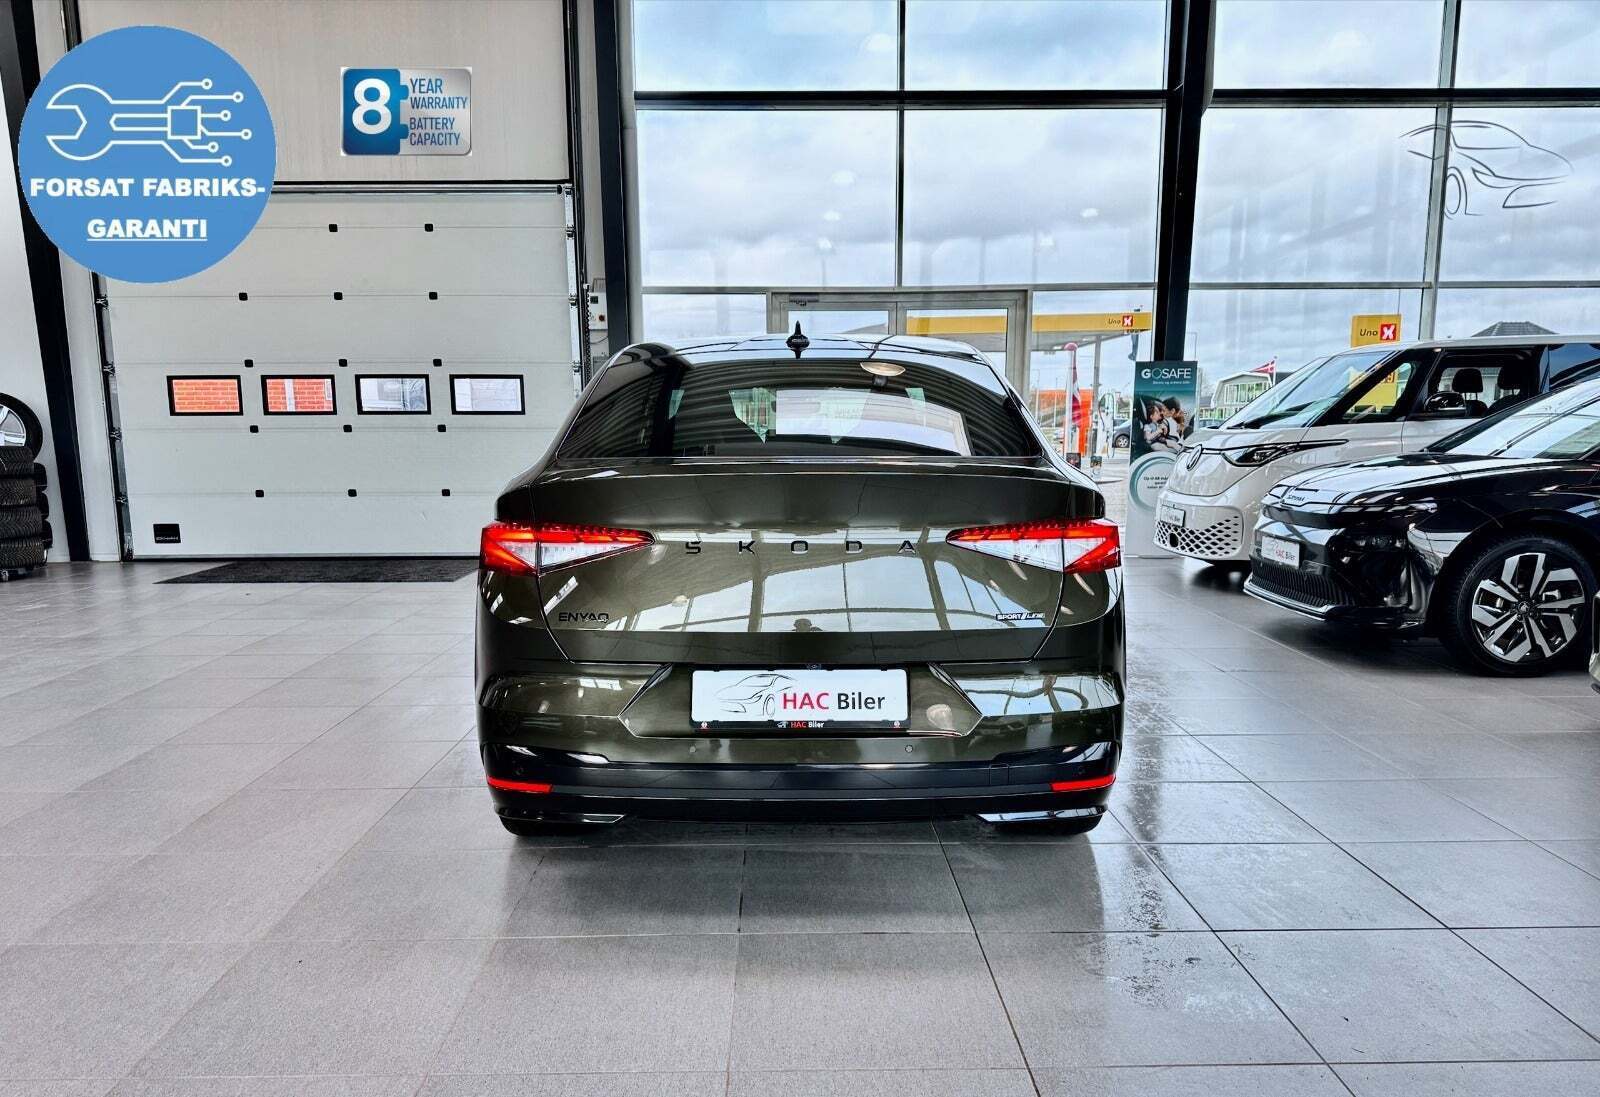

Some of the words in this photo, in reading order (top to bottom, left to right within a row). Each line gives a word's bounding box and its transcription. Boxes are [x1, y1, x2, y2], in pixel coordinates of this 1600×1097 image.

[1360, 328, 1378, 337] Uno
[1141, 367, 1192, 380] GOSAFE
[685, 540, 917, 555] SKODA
[558, 612, 609, 623] ENYAQ
[782, 692, 829, 710] HAC
[837, 691, 886, 710] Biler
[808, 720, 825, 729] Biler
